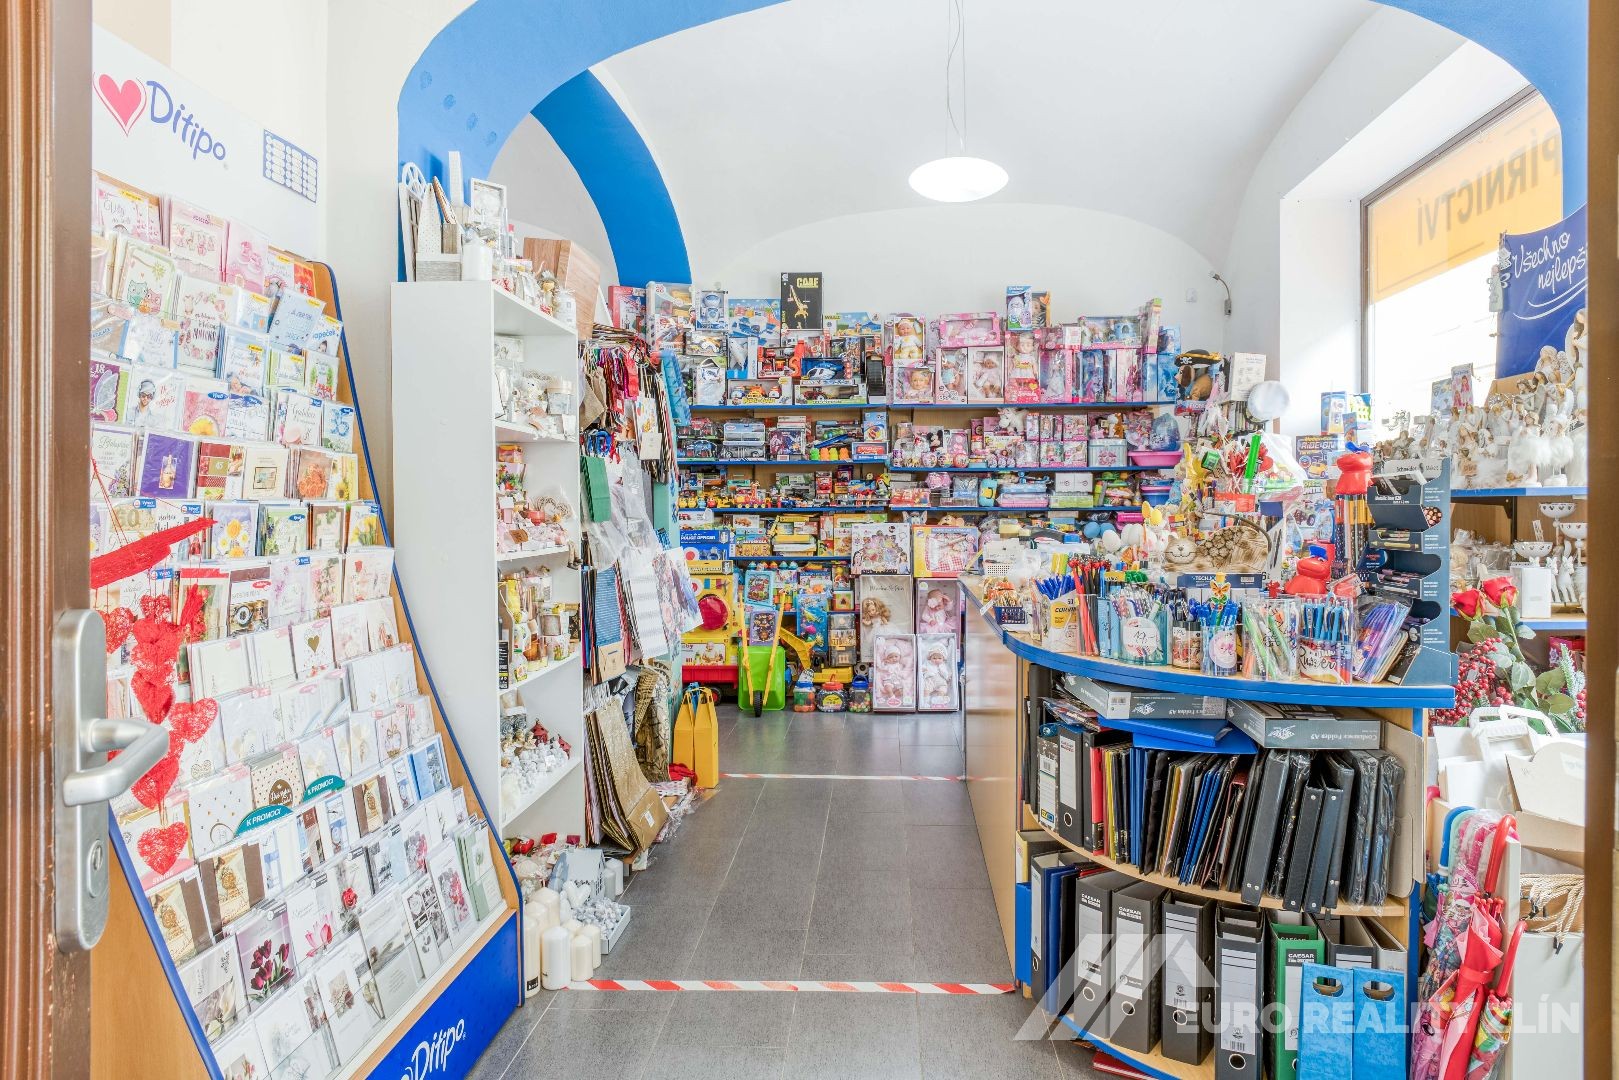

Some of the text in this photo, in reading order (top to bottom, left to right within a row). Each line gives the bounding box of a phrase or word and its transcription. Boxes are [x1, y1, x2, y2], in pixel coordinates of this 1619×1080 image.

[146, 80, 226, 161] Ditipo
[1512, 232, 1571, 279] Všechno
[1538, 245, 1588, 294] nejlepš
[312, 777, 334, 793] PROMOCI
[252, 807, 281, 824] PROMOCI
[411, 1019, 465, 1080] Ditipo
